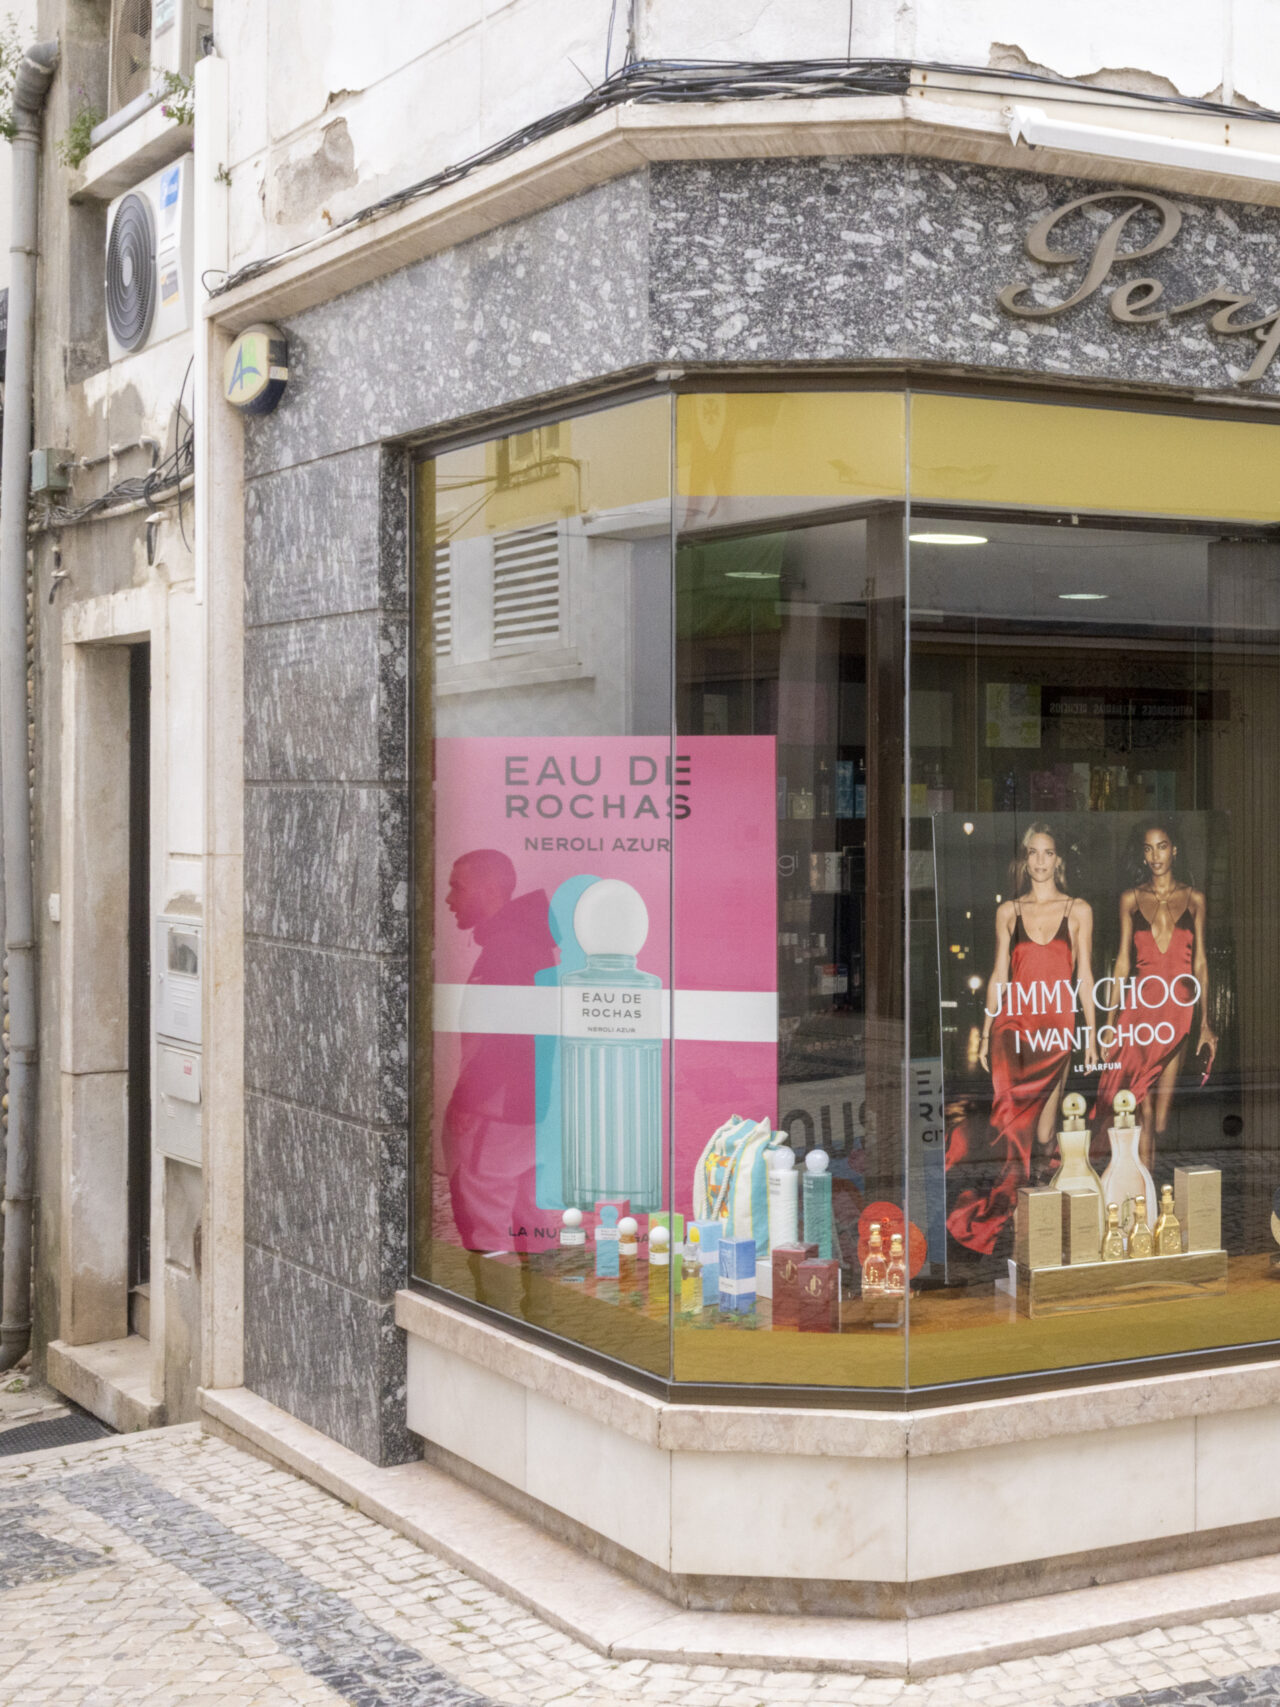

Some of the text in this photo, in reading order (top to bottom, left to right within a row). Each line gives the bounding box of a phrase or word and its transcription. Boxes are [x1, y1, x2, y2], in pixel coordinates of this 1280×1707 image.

[505, 755, 692, 786] EAU DE
[505, 794, 692, 820] ROCHAS
[524, 837, 671, 852] NEROLI AZUR
[582, 992, 641, 1004] EAU DE
[984, 973, 1201, 1018] JIMMY CHOO
[582, 1008, 642, 1019] ROCHAS
[1015, 1021, 1175, 1054] I WANT CHOO
[1074, 1062, 1122, 1073] LE PARFUM
[508, 1226, 528, 1237] LA
